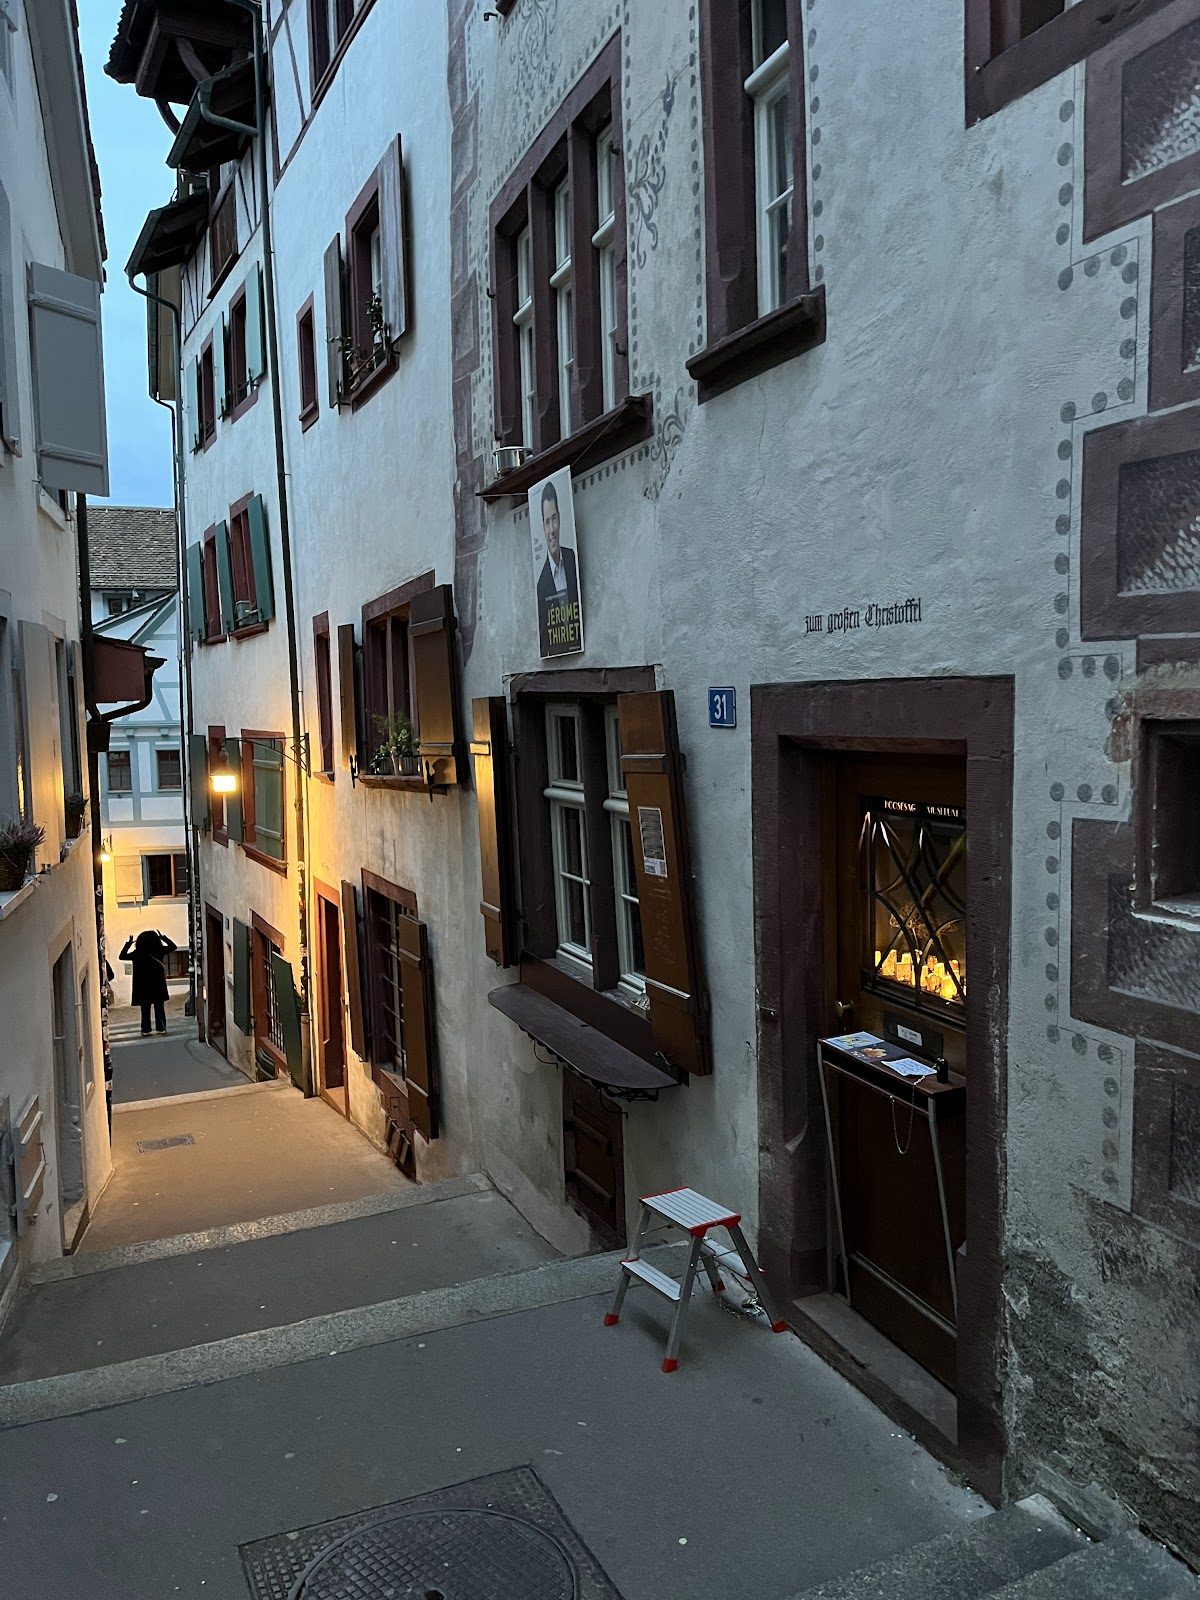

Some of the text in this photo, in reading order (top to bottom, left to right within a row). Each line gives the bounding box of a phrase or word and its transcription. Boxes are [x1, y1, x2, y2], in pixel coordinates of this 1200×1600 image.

[546, 601, 579, 627] JÉRÔME
[803, 615, 823, 638] zum
[864, 597, 922, 631] Christoffel
[547, 622, 580, 647] THIRIET
[713, 694, 727, 720] 31
